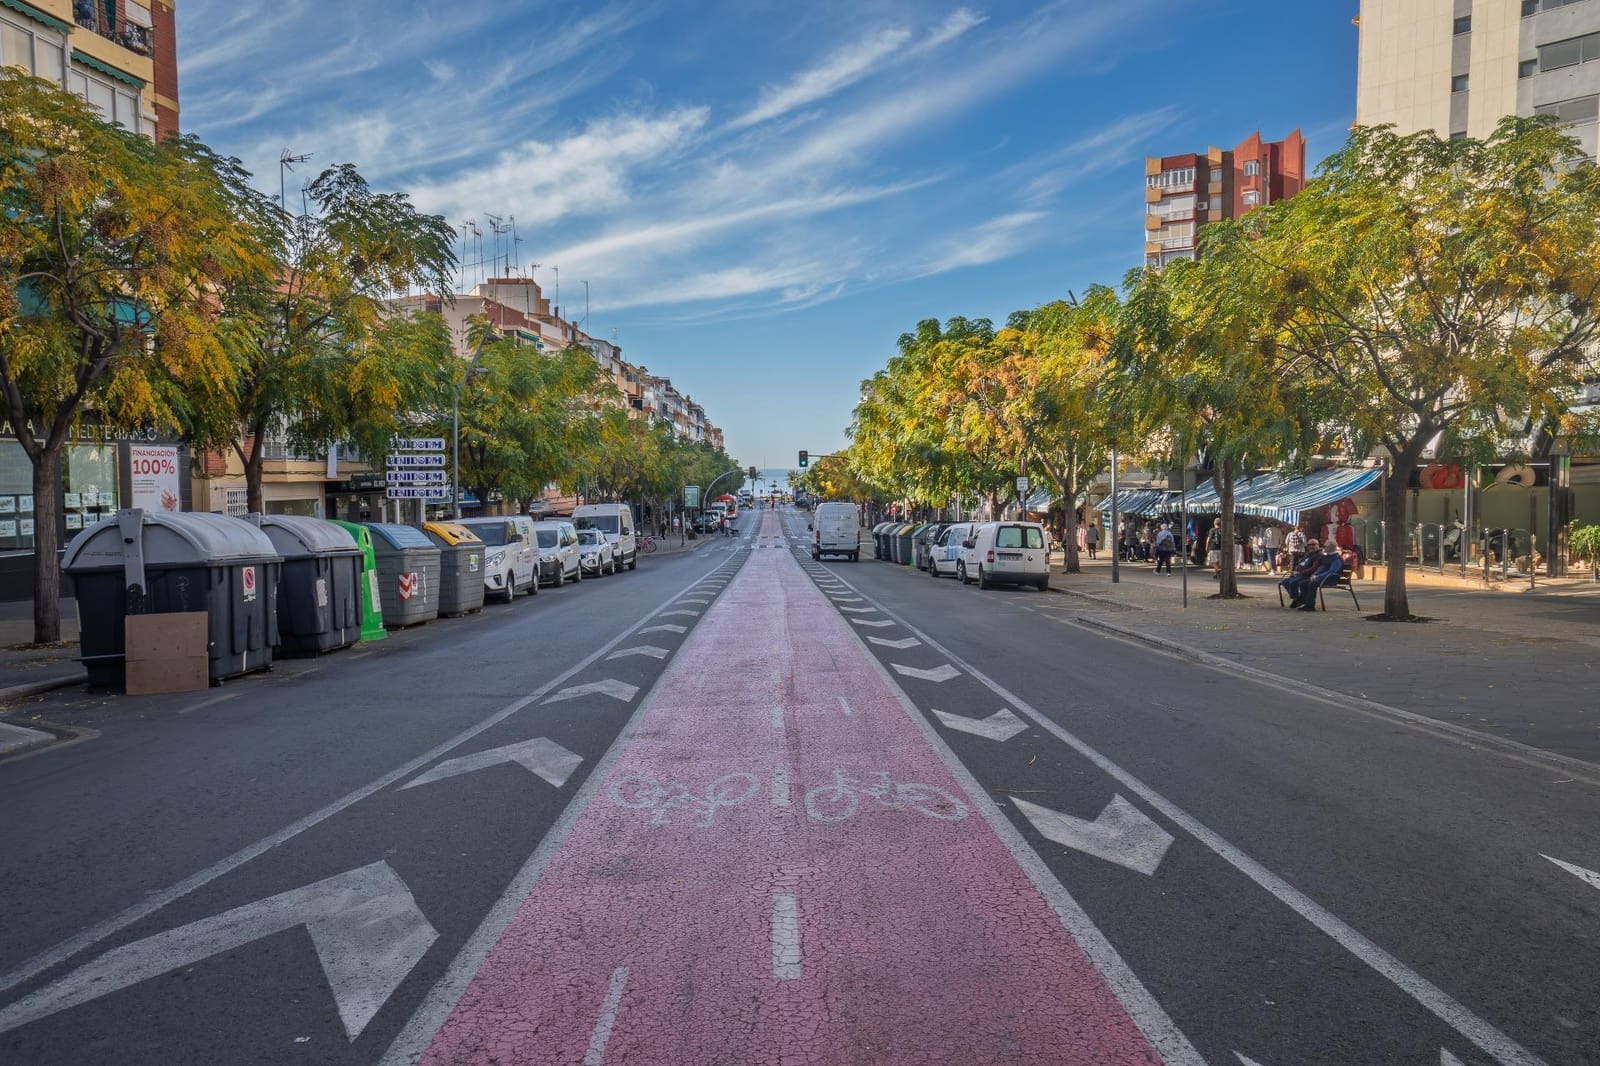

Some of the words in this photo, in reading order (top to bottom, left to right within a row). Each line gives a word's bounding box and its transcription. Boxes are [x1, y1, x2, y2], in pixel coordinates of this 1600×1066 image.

[69, 423, 157, 441] MEDTERRANO
[390, 440, 442, 449] NIDORM
[132, 449, 175, 457] FINANCIACIÓN
[387, 456, 443, 465] BENIDORM
[133, 459, 175, 475] 100%
[387, 472, 443, 481] BENIDORM
[388, 489, 443, 497] BENIDORM
